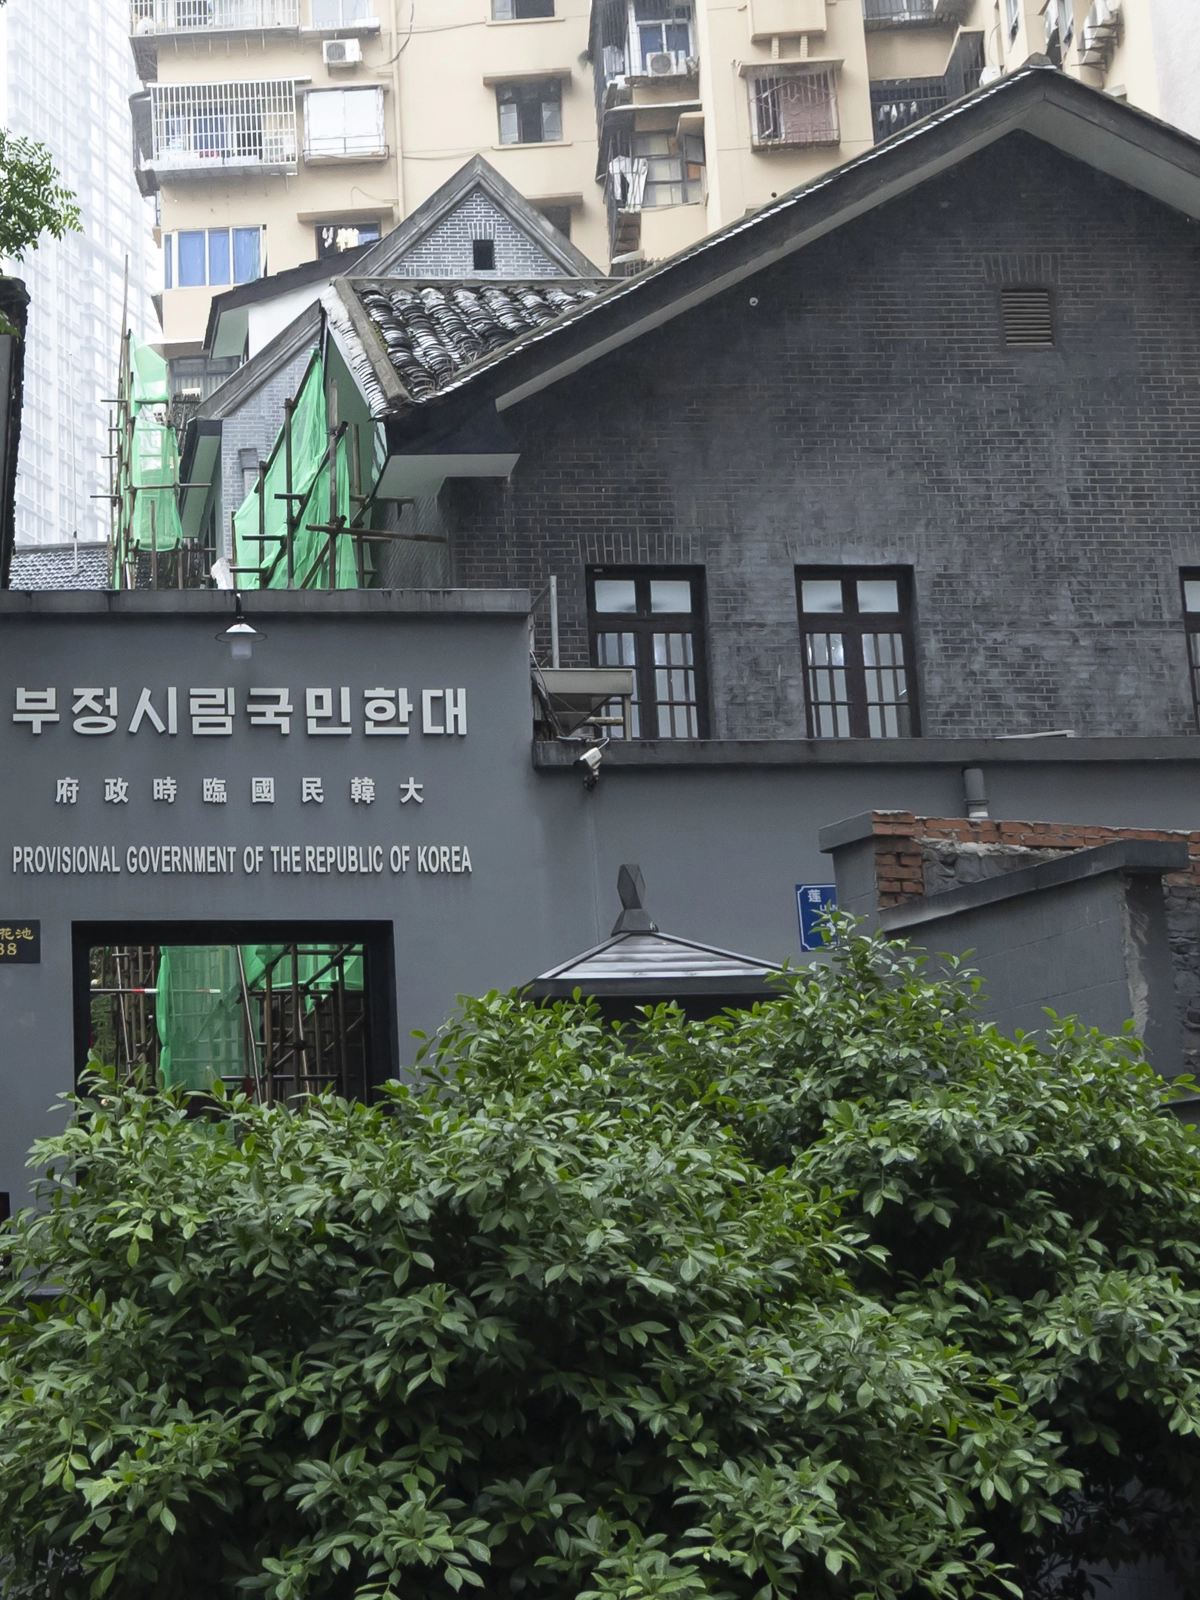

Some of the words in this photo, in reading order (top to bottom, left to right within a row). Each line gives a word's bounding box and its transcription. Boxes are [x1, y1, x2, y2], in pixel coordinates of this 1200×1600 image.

[12, 845, 121, 873] PROVISIONAL
[126, 845, 237, 873] GOVERNMENT
[243, 845, 264, 873] OF
[270, 845, 302, 873] THE
[305, 845, 384, 873] REPUBLIC
[390, 845, 410, 873] OF
[417, 845, 473, 873] KOREA
